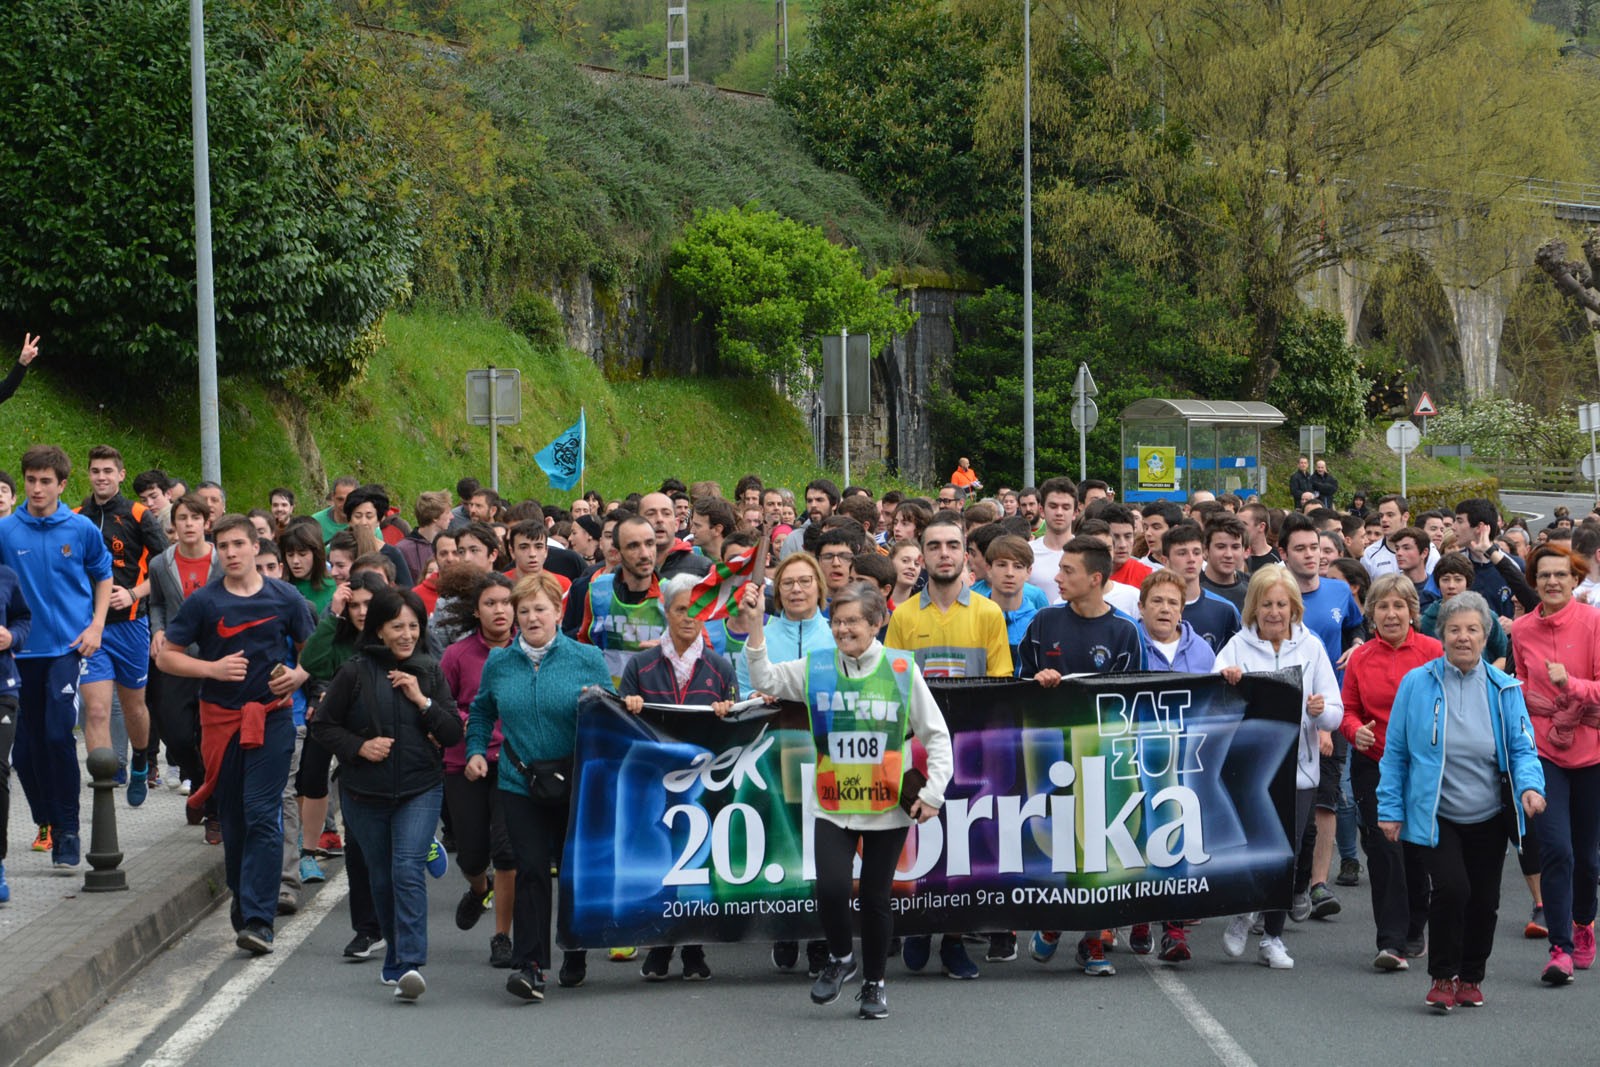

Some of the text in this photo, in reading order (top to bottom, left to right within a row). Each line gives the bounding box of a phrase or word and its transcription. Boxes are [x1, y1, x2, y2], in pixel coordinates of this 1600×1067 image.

[816, 691, 859, 711] BAT
[855, 700, 901, 722] ZUK
[1096, 689, 1192, 737] BAT
[662, 722, 776, 794] aek
[837, 737, 879, 758] 1108
[1111, 733, 1208, 780] ZUK
[662, 755, 1211, 887] 20. orrika
[662, 876, 1211, 918] 2017ko martxoare apirilaren 9ra OTXANDIOTIK IRUÑERA
